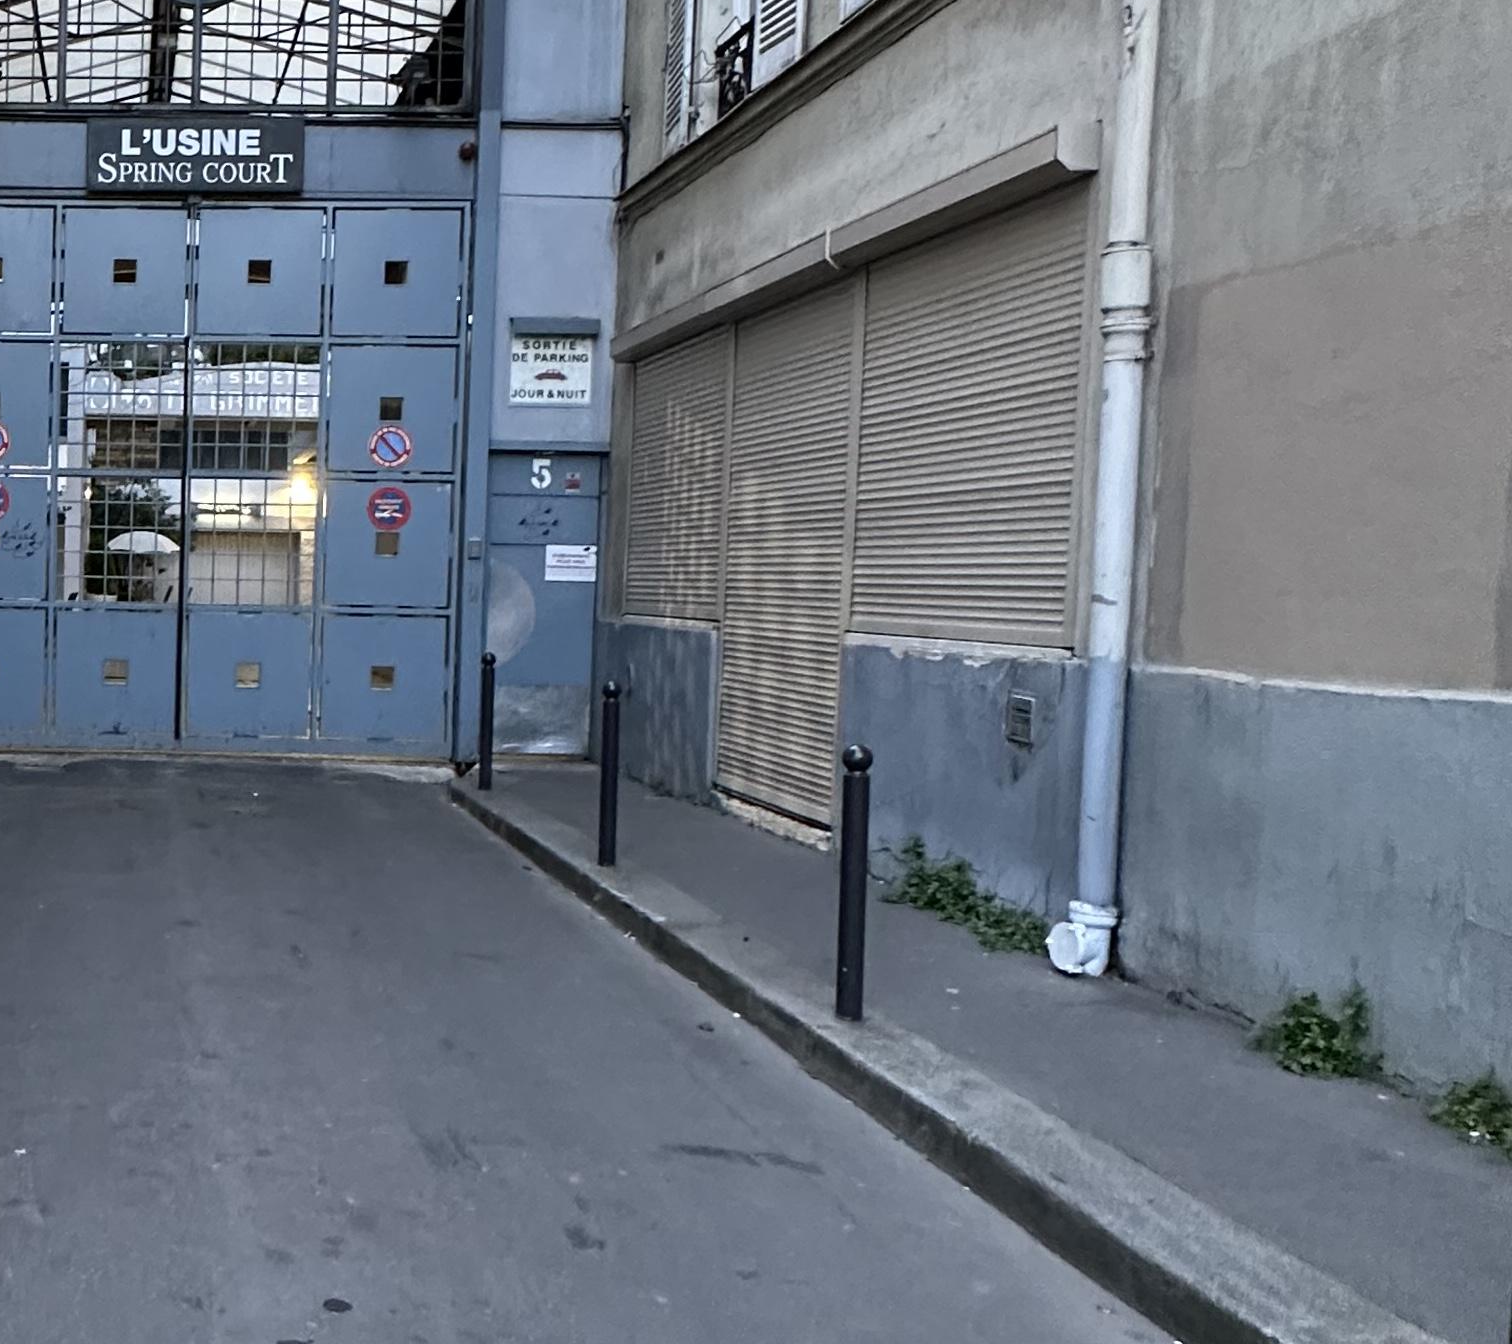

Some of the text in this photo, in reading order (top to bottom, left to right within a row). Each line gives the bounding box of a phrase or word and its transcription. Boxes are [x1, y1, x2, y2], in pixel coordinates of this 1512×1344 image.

[121, 129, 261, 156] L'USINE
[98, 153, 293, 184] SPRING COURT
[522, 340, 577, 351] SORTIE
[511, 353, 589, 363] DE PARKING
[229, 370, 309, 385] SOCETE
[510, 389, 545, 399] JOUR
[556, 389, 587, 399] NUIT
[530, 458, 552, 489] 5
